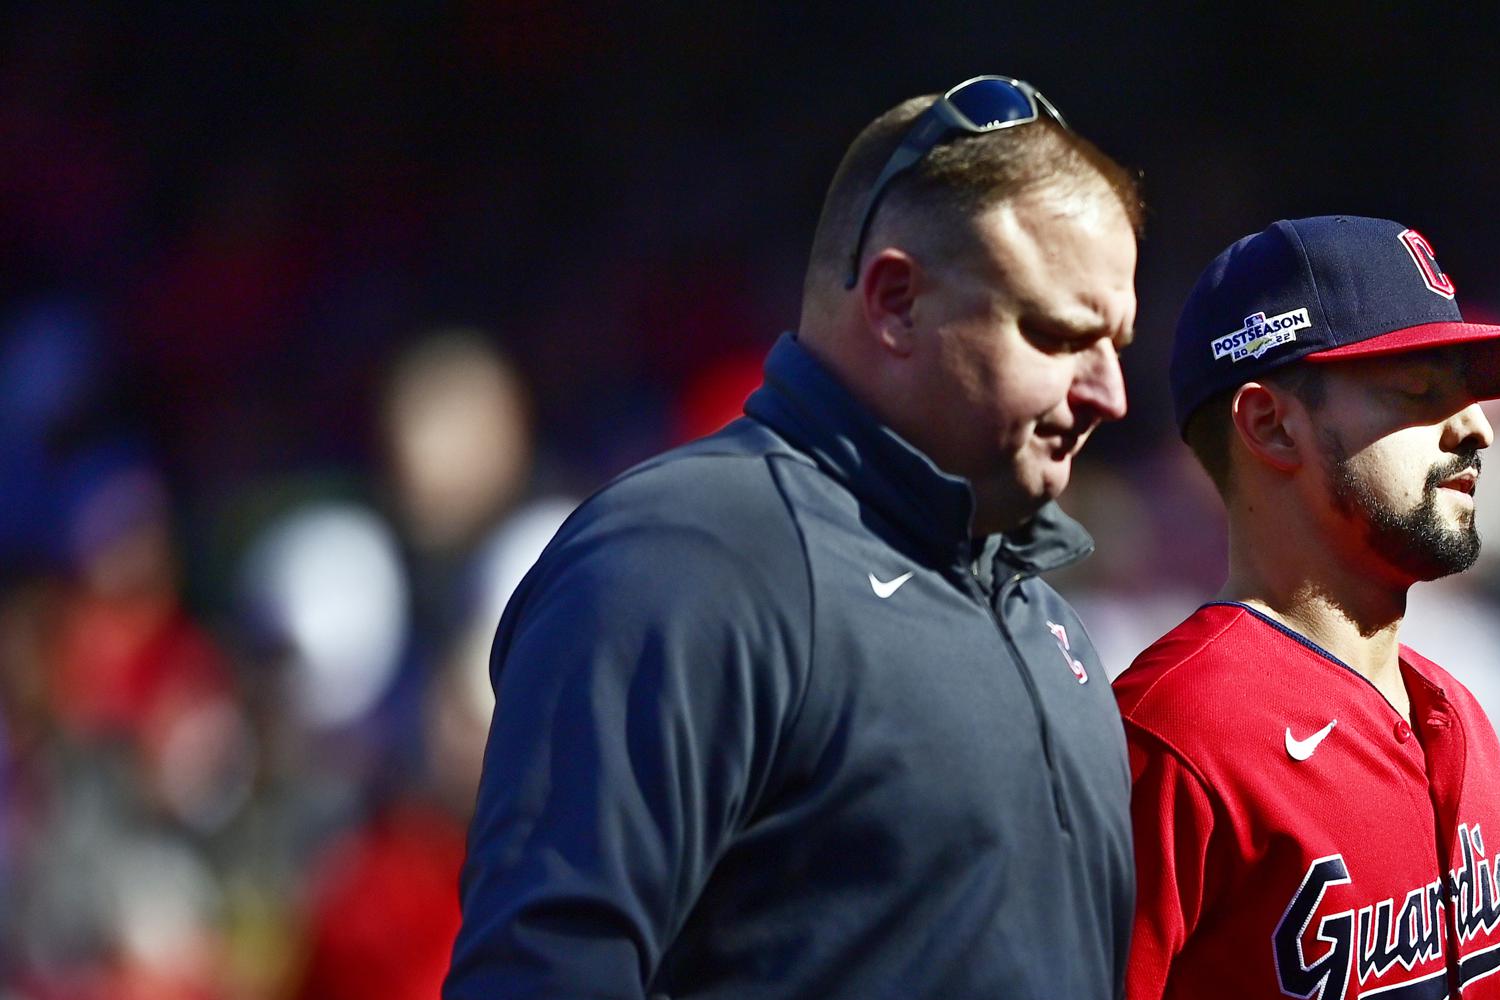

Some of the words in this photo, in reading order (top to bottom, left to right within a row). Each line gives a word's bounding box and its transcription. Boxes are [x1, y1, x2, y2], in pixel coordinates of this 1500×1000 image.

[1397, 229, 1455, 300] C
[1214, 313, 1305, 355] POSTSEASON
[1275, 333, 1291, 343] 22
